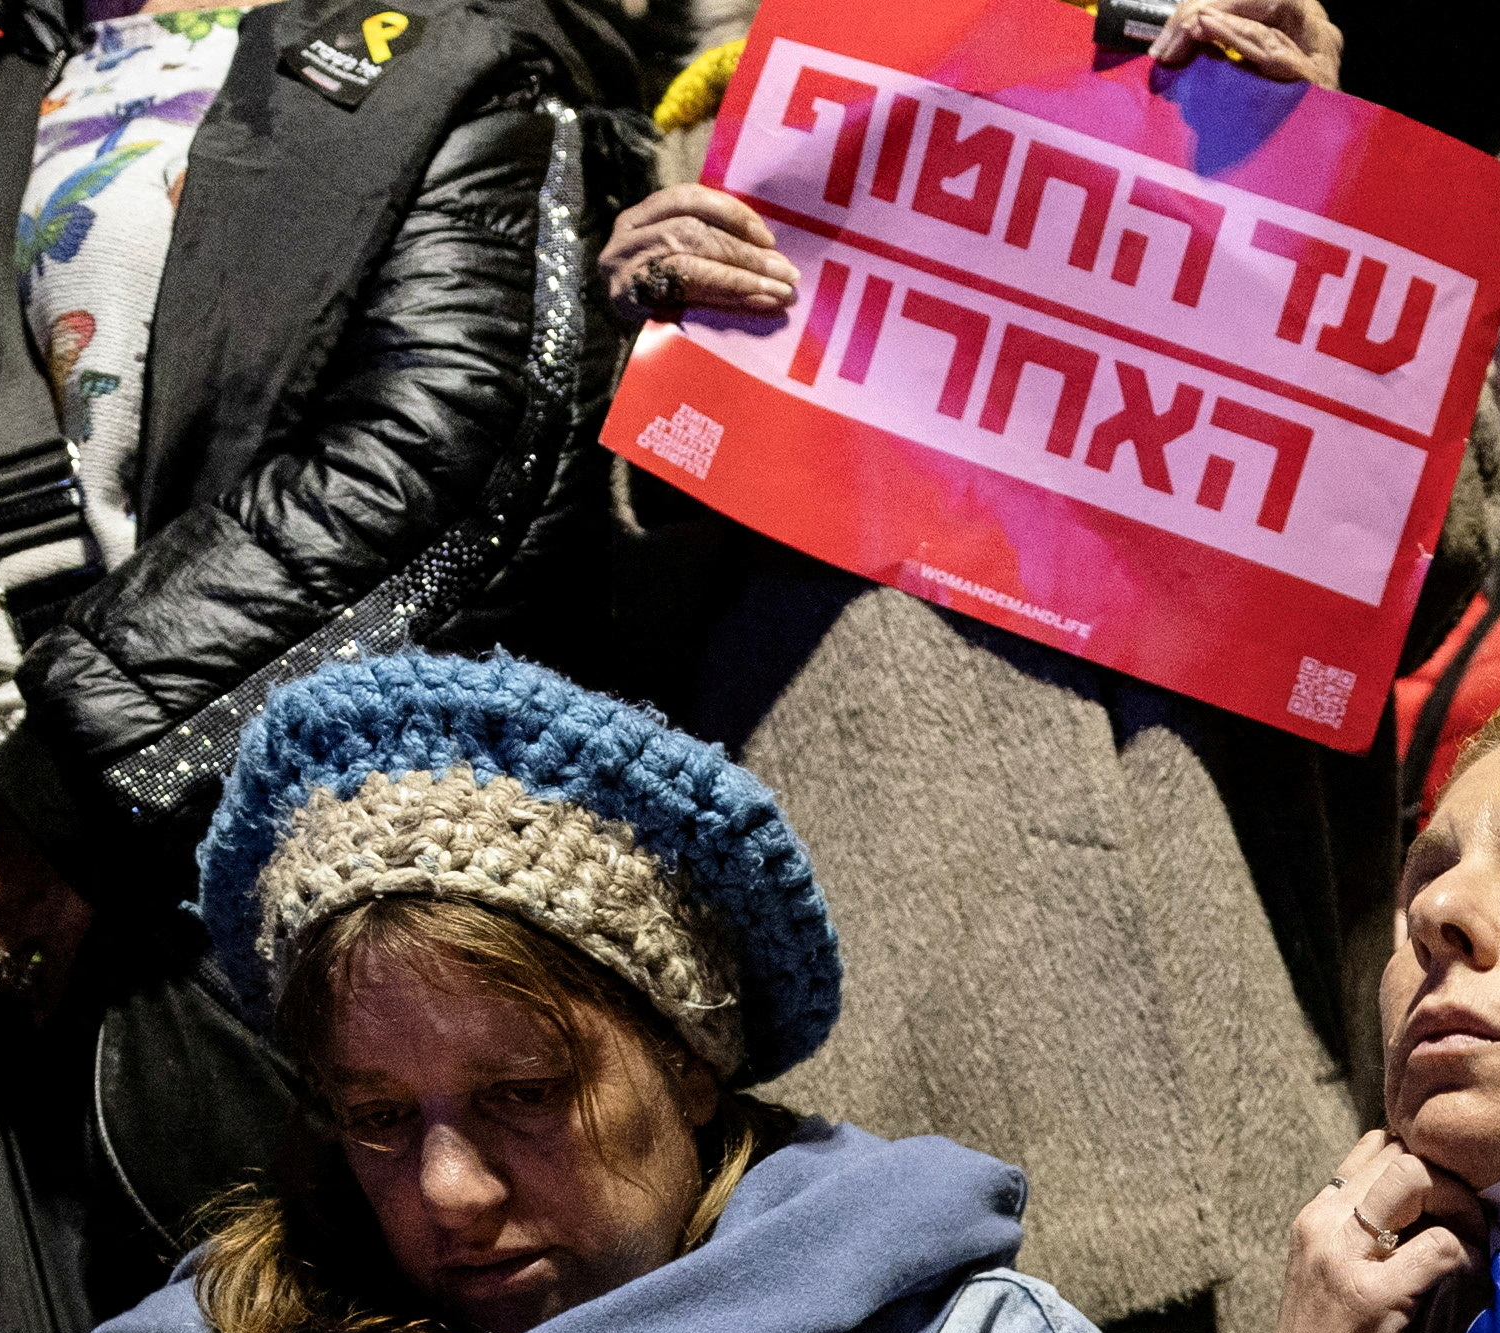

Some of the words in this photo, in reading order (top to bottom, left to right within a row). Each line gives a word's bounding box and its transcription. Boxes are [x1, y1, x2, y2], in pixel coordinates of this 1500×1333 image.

[782, 66, 1229, 310] החטוף
[1249, 217, 1436, 376] עד
[788, 258, 1315, 533] האחרון
